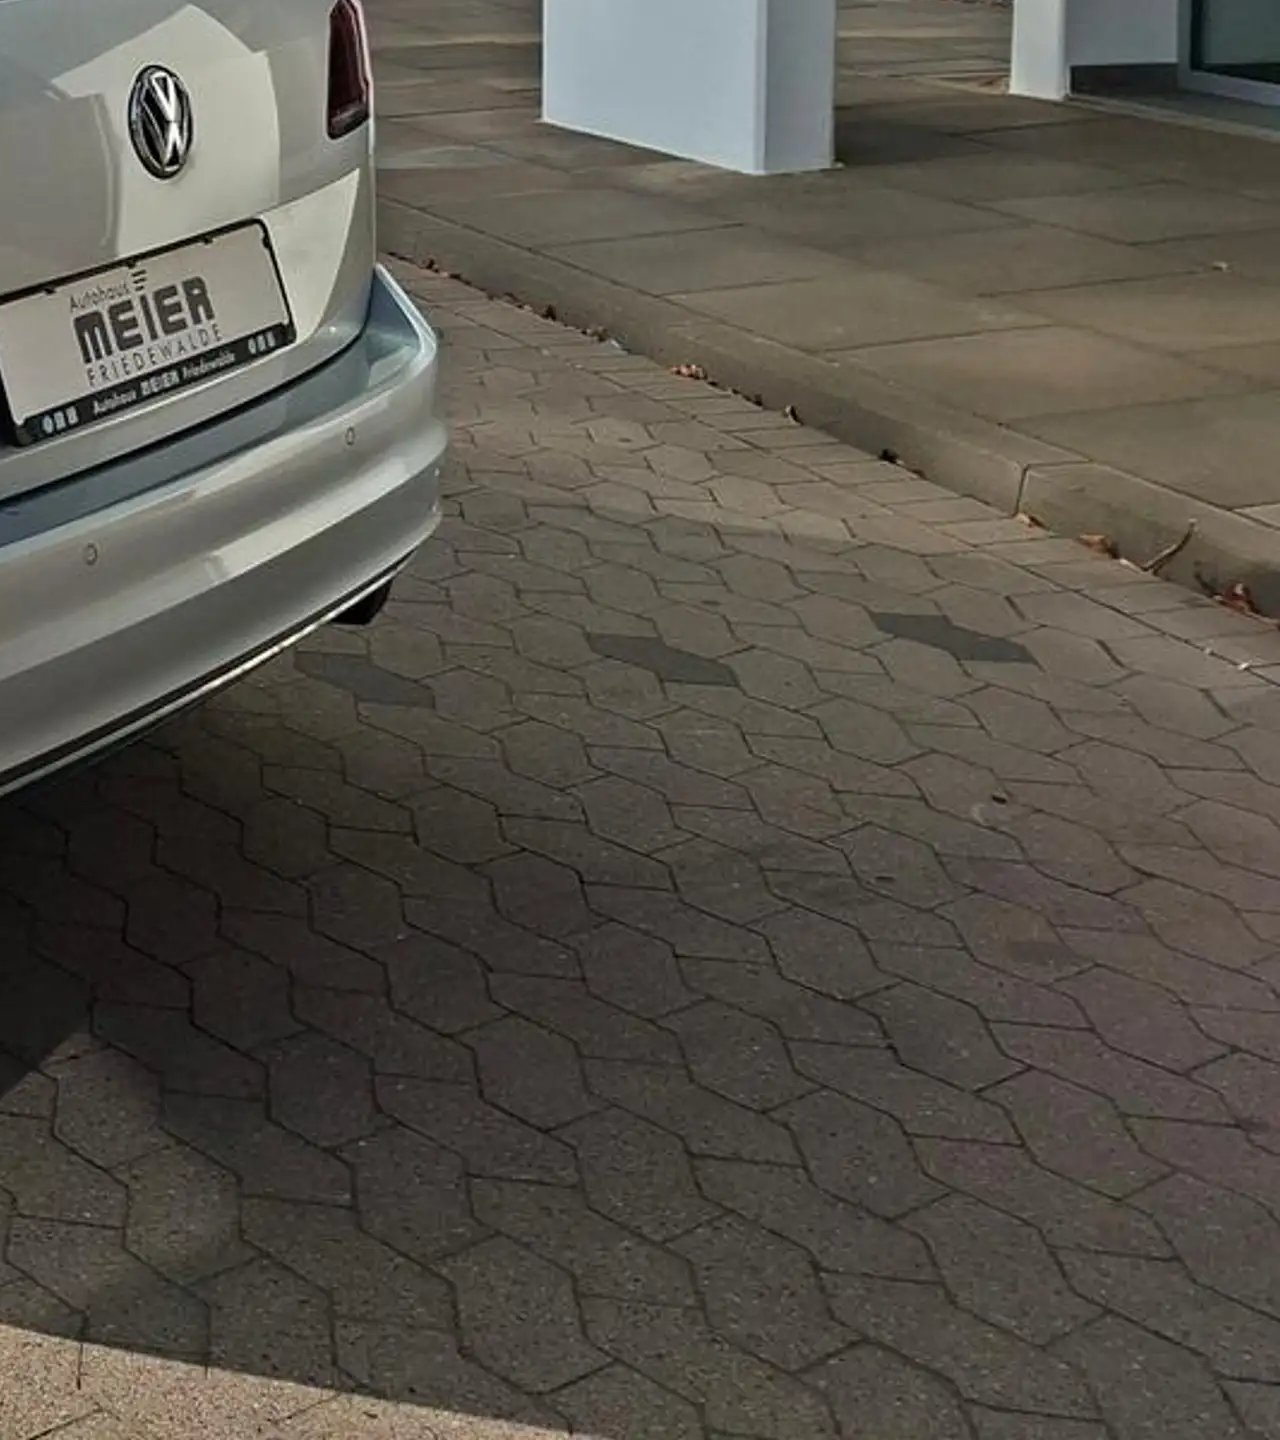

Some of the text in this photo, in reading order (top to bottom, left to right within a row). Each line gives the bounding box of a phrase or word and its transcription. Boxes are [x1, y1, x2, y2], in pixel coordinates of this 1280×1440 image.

[69, 281, 130, 311] Autohaus
[73, 275, 216, 364] MEIER
[85, 323, 223, 388] FRIEDEWALDE
